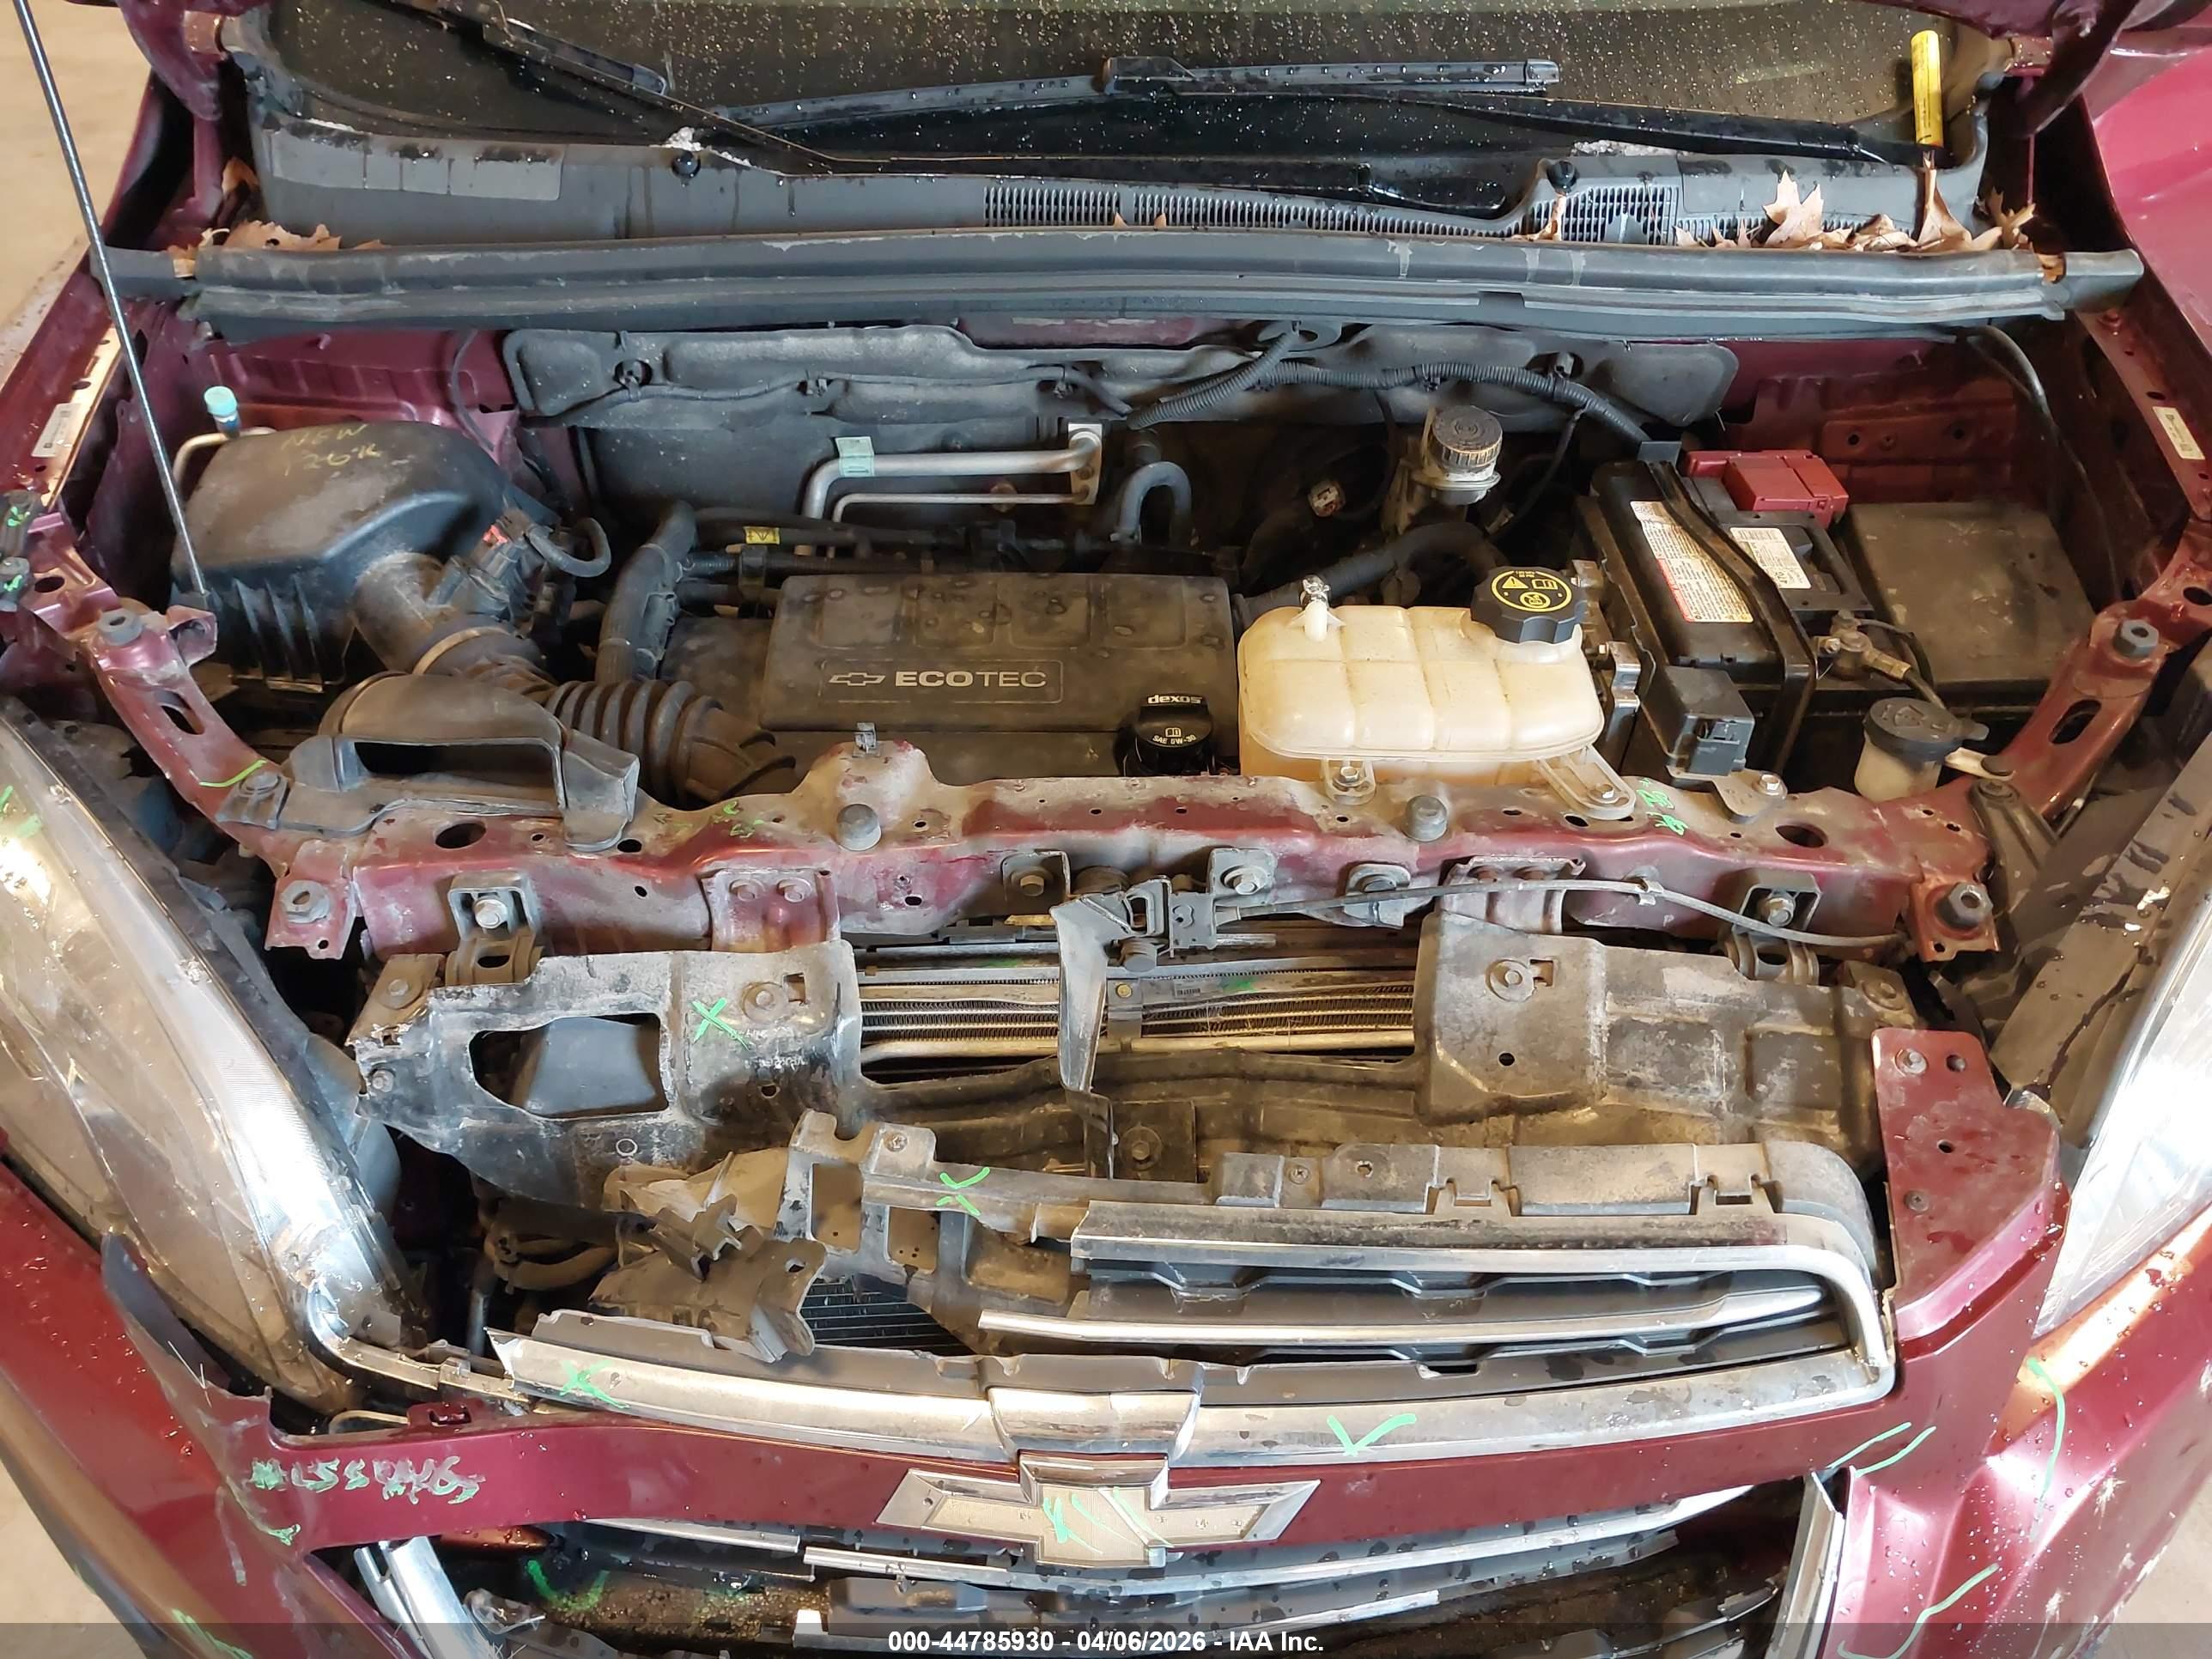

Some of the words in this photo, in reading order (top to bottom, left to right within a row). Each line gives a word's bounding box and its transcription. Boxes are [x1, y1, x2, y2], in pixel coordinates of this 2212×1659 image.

[895, 671, 1047, 688] ECOTEC
[1147, 694, 1203, 704] dexos
[1152, 734, 1169, 744] SAE
